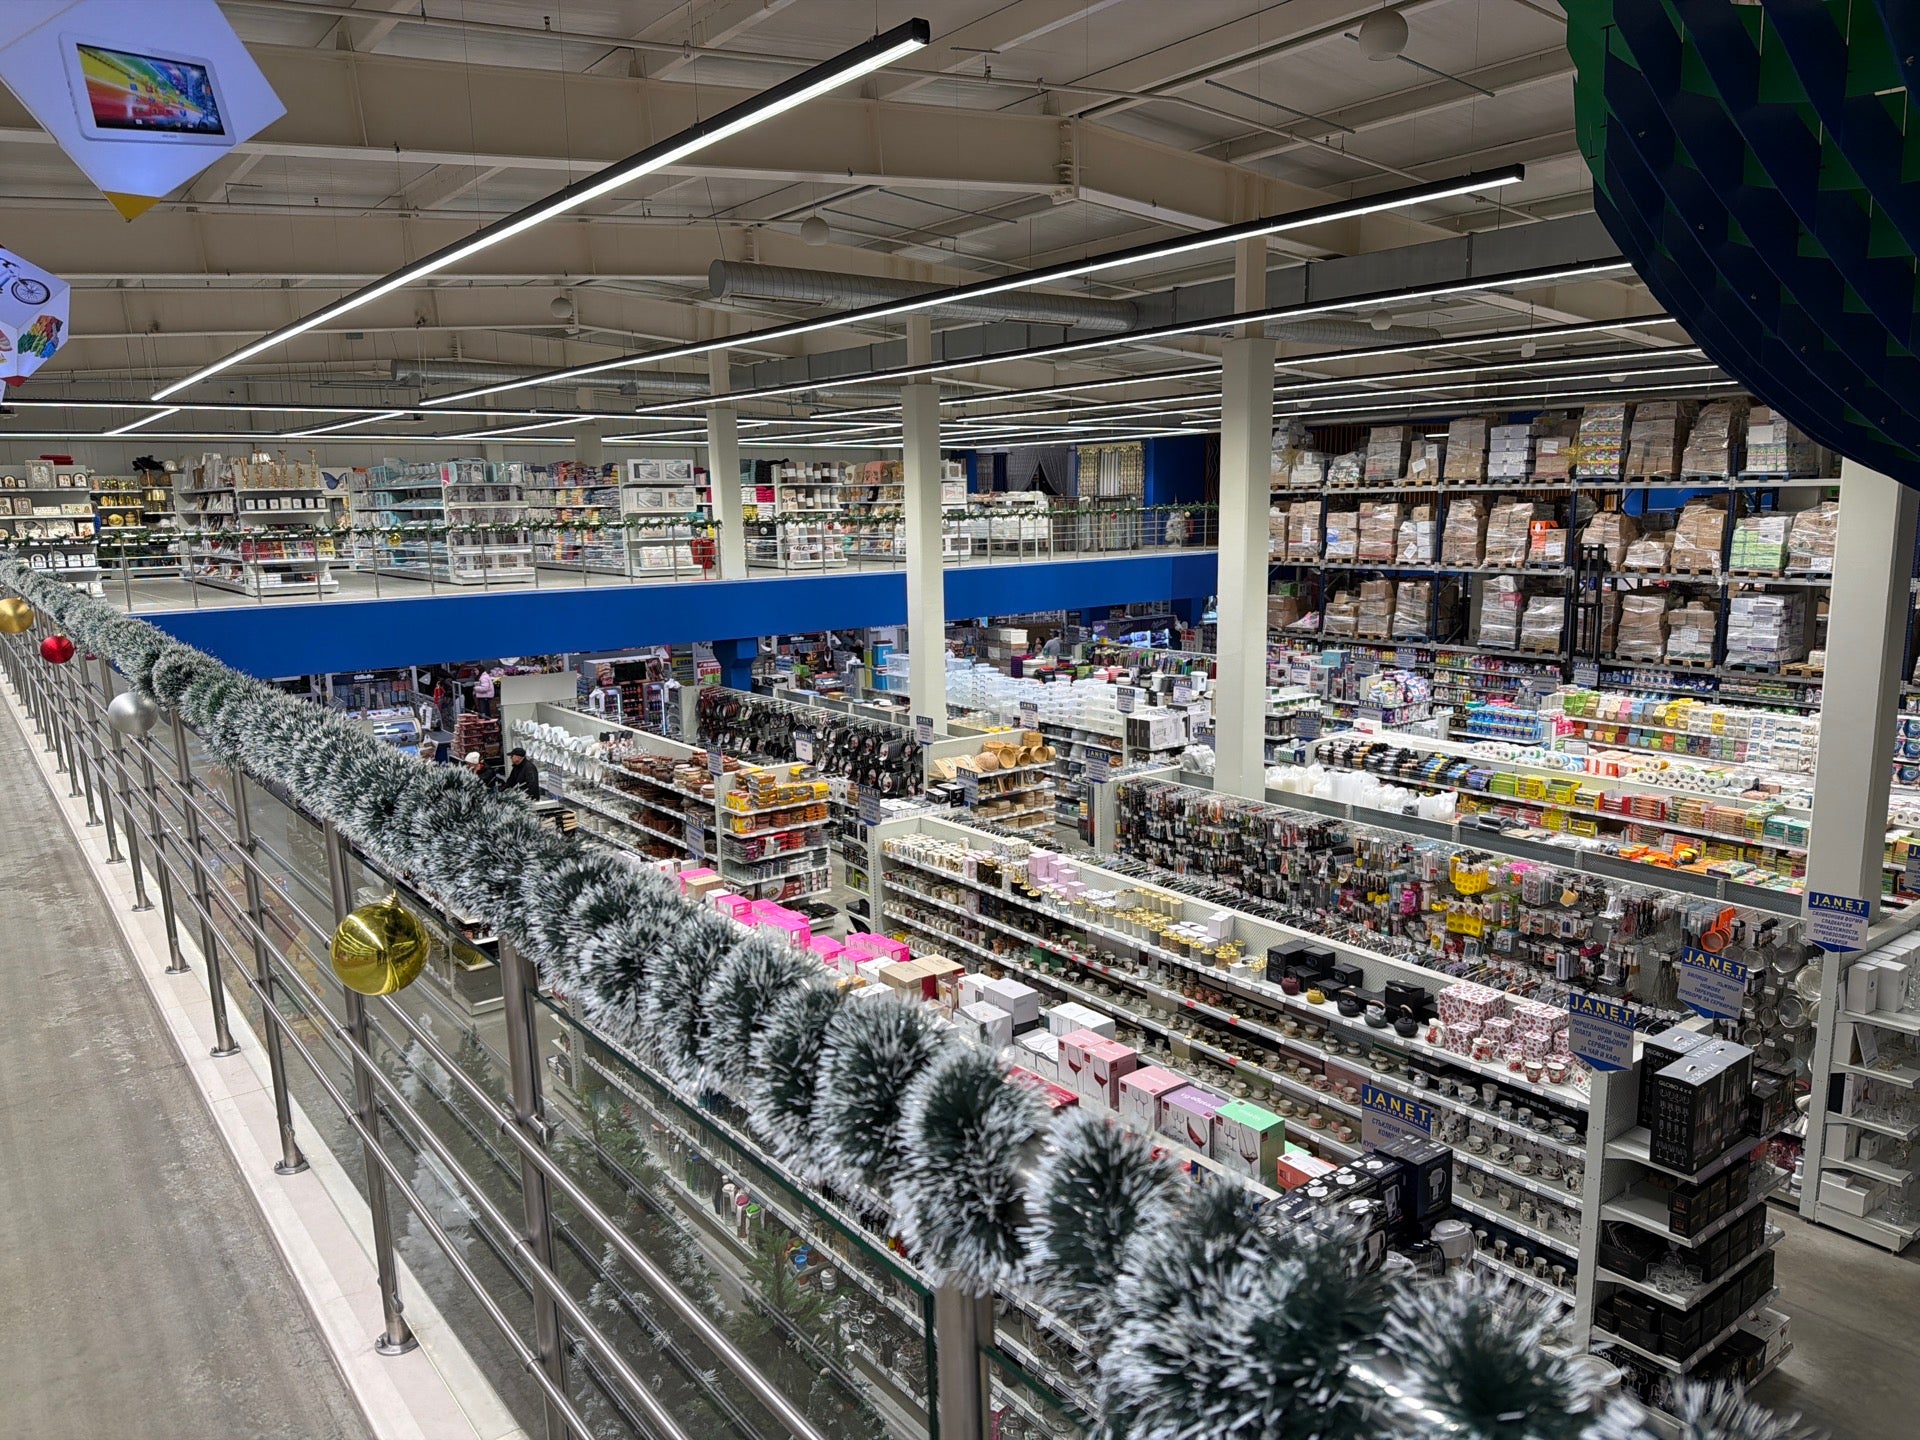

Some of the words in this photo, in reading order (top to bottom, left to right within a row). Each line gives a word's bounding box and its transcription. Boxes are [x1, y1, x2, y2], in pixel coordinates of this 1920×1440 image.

[1359, 700, 1382, 709] JANET
[1812, 894, 1864, 910] JANET
[1684, 950, 1745, 976] JANET
[1700, 982, 1721, 994] НОЖОВЕ
[1679, 988, 1702, 1000] ПРИБОРИ
[1710, 998, 1740, 1012] СЕРВИРАНЕ
[1572, 996, 1632, 1021] JANET
[1572, 1018, 1612, 1036] ПОРЦЕЛАНОВИ
[1614, 1030, 1630, 1041] ЧАШИ
[1574, 1028, 1592, 1038] ПЛАТА
[1588, 1040, 1614, 1052] СЕРВИЗИ
[1588, 1048, 1599, 1056] ЧАЙ
[1658, 1080, 1679, 1091] GLOBO
[1364, 1088, 1428, 1121] JANET
[1372, 1102, 1396, 1115] GRAND
[1398, 1112, 1428, 1128] MARKET
[1372, 1118, 1400, 1134] СТЪКЛЕНИ
